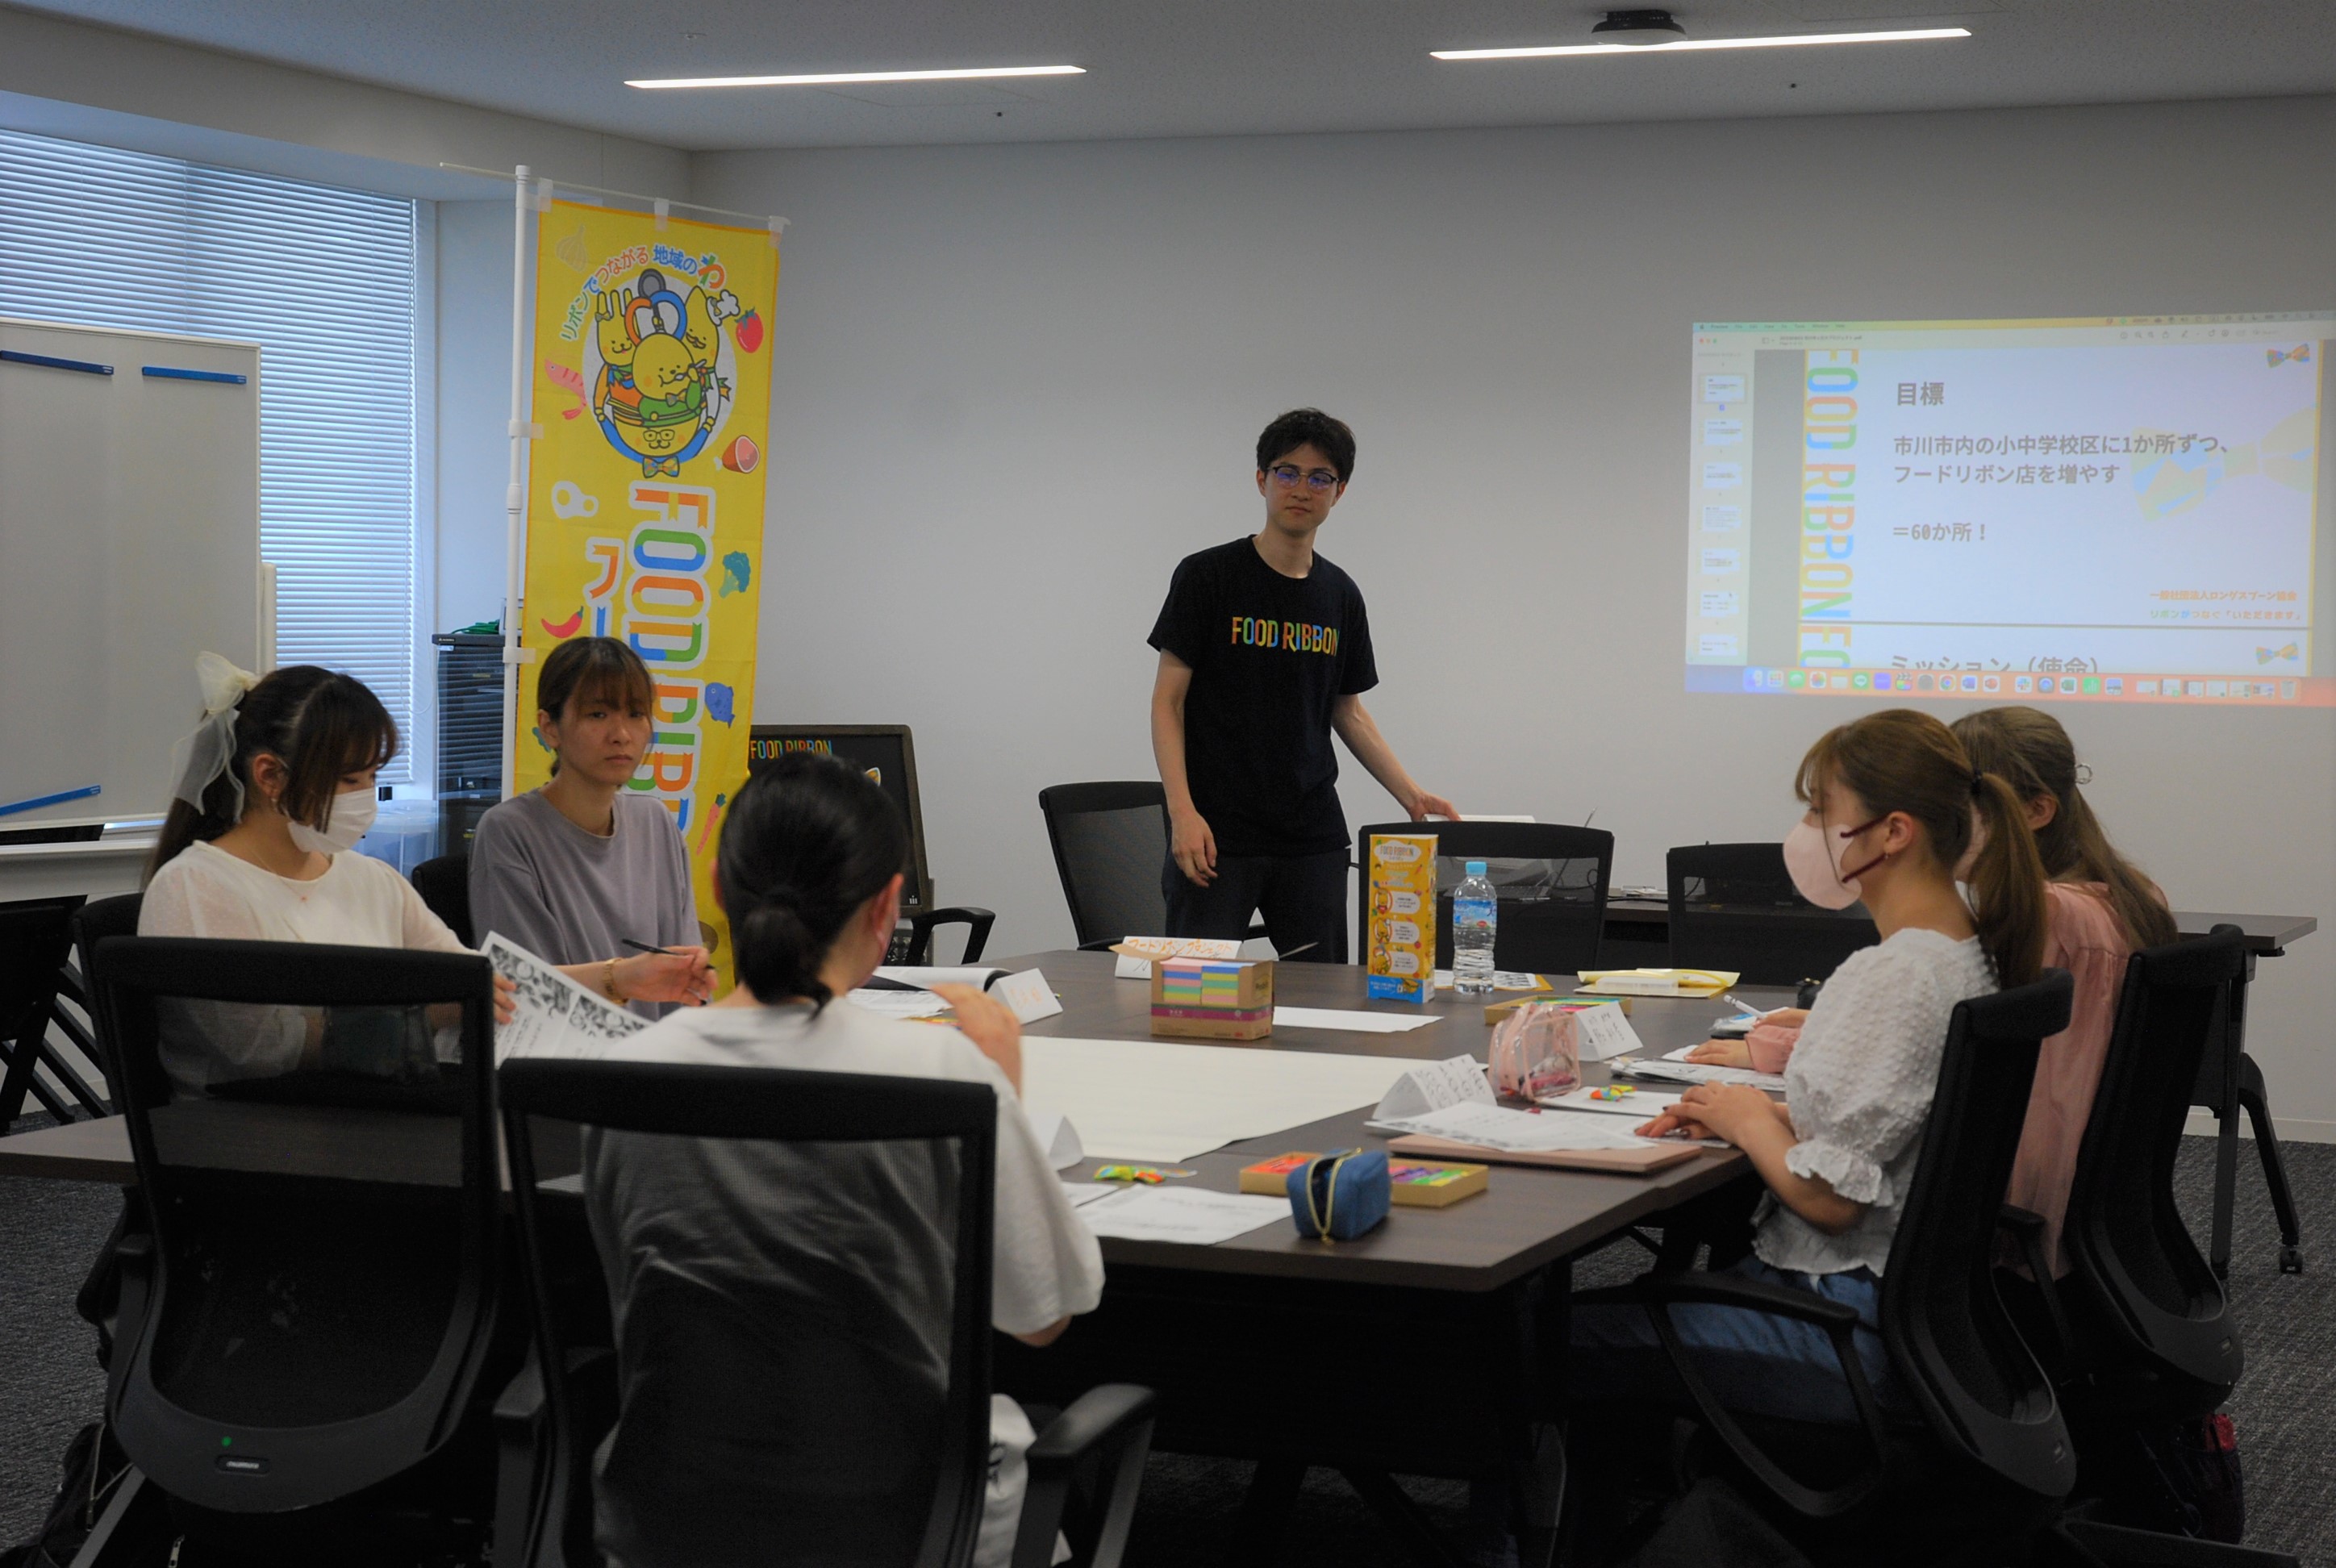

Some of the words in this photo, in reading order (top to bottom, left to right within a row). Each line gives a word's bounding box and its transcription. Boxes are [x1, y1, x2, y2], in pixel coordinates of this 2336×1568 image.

[561, 246, 649, 340] リボンでつながる
[1896, 382, 1945, 407] 目標
[1893, 434, 2230, 457] 市川市内の小中学校区に1か所ずつ、
[1893, 464, 2121, 485] フードリボン店を増やす
[1801, 464, 1856, 618] RIBBON
[629, 488, 709, 662] FOOD
[1231, 616, 1279, 648] FOOD
[1282, 621, 1341, 657] RIBBON
[750, 739, 784, 760] FOOD
